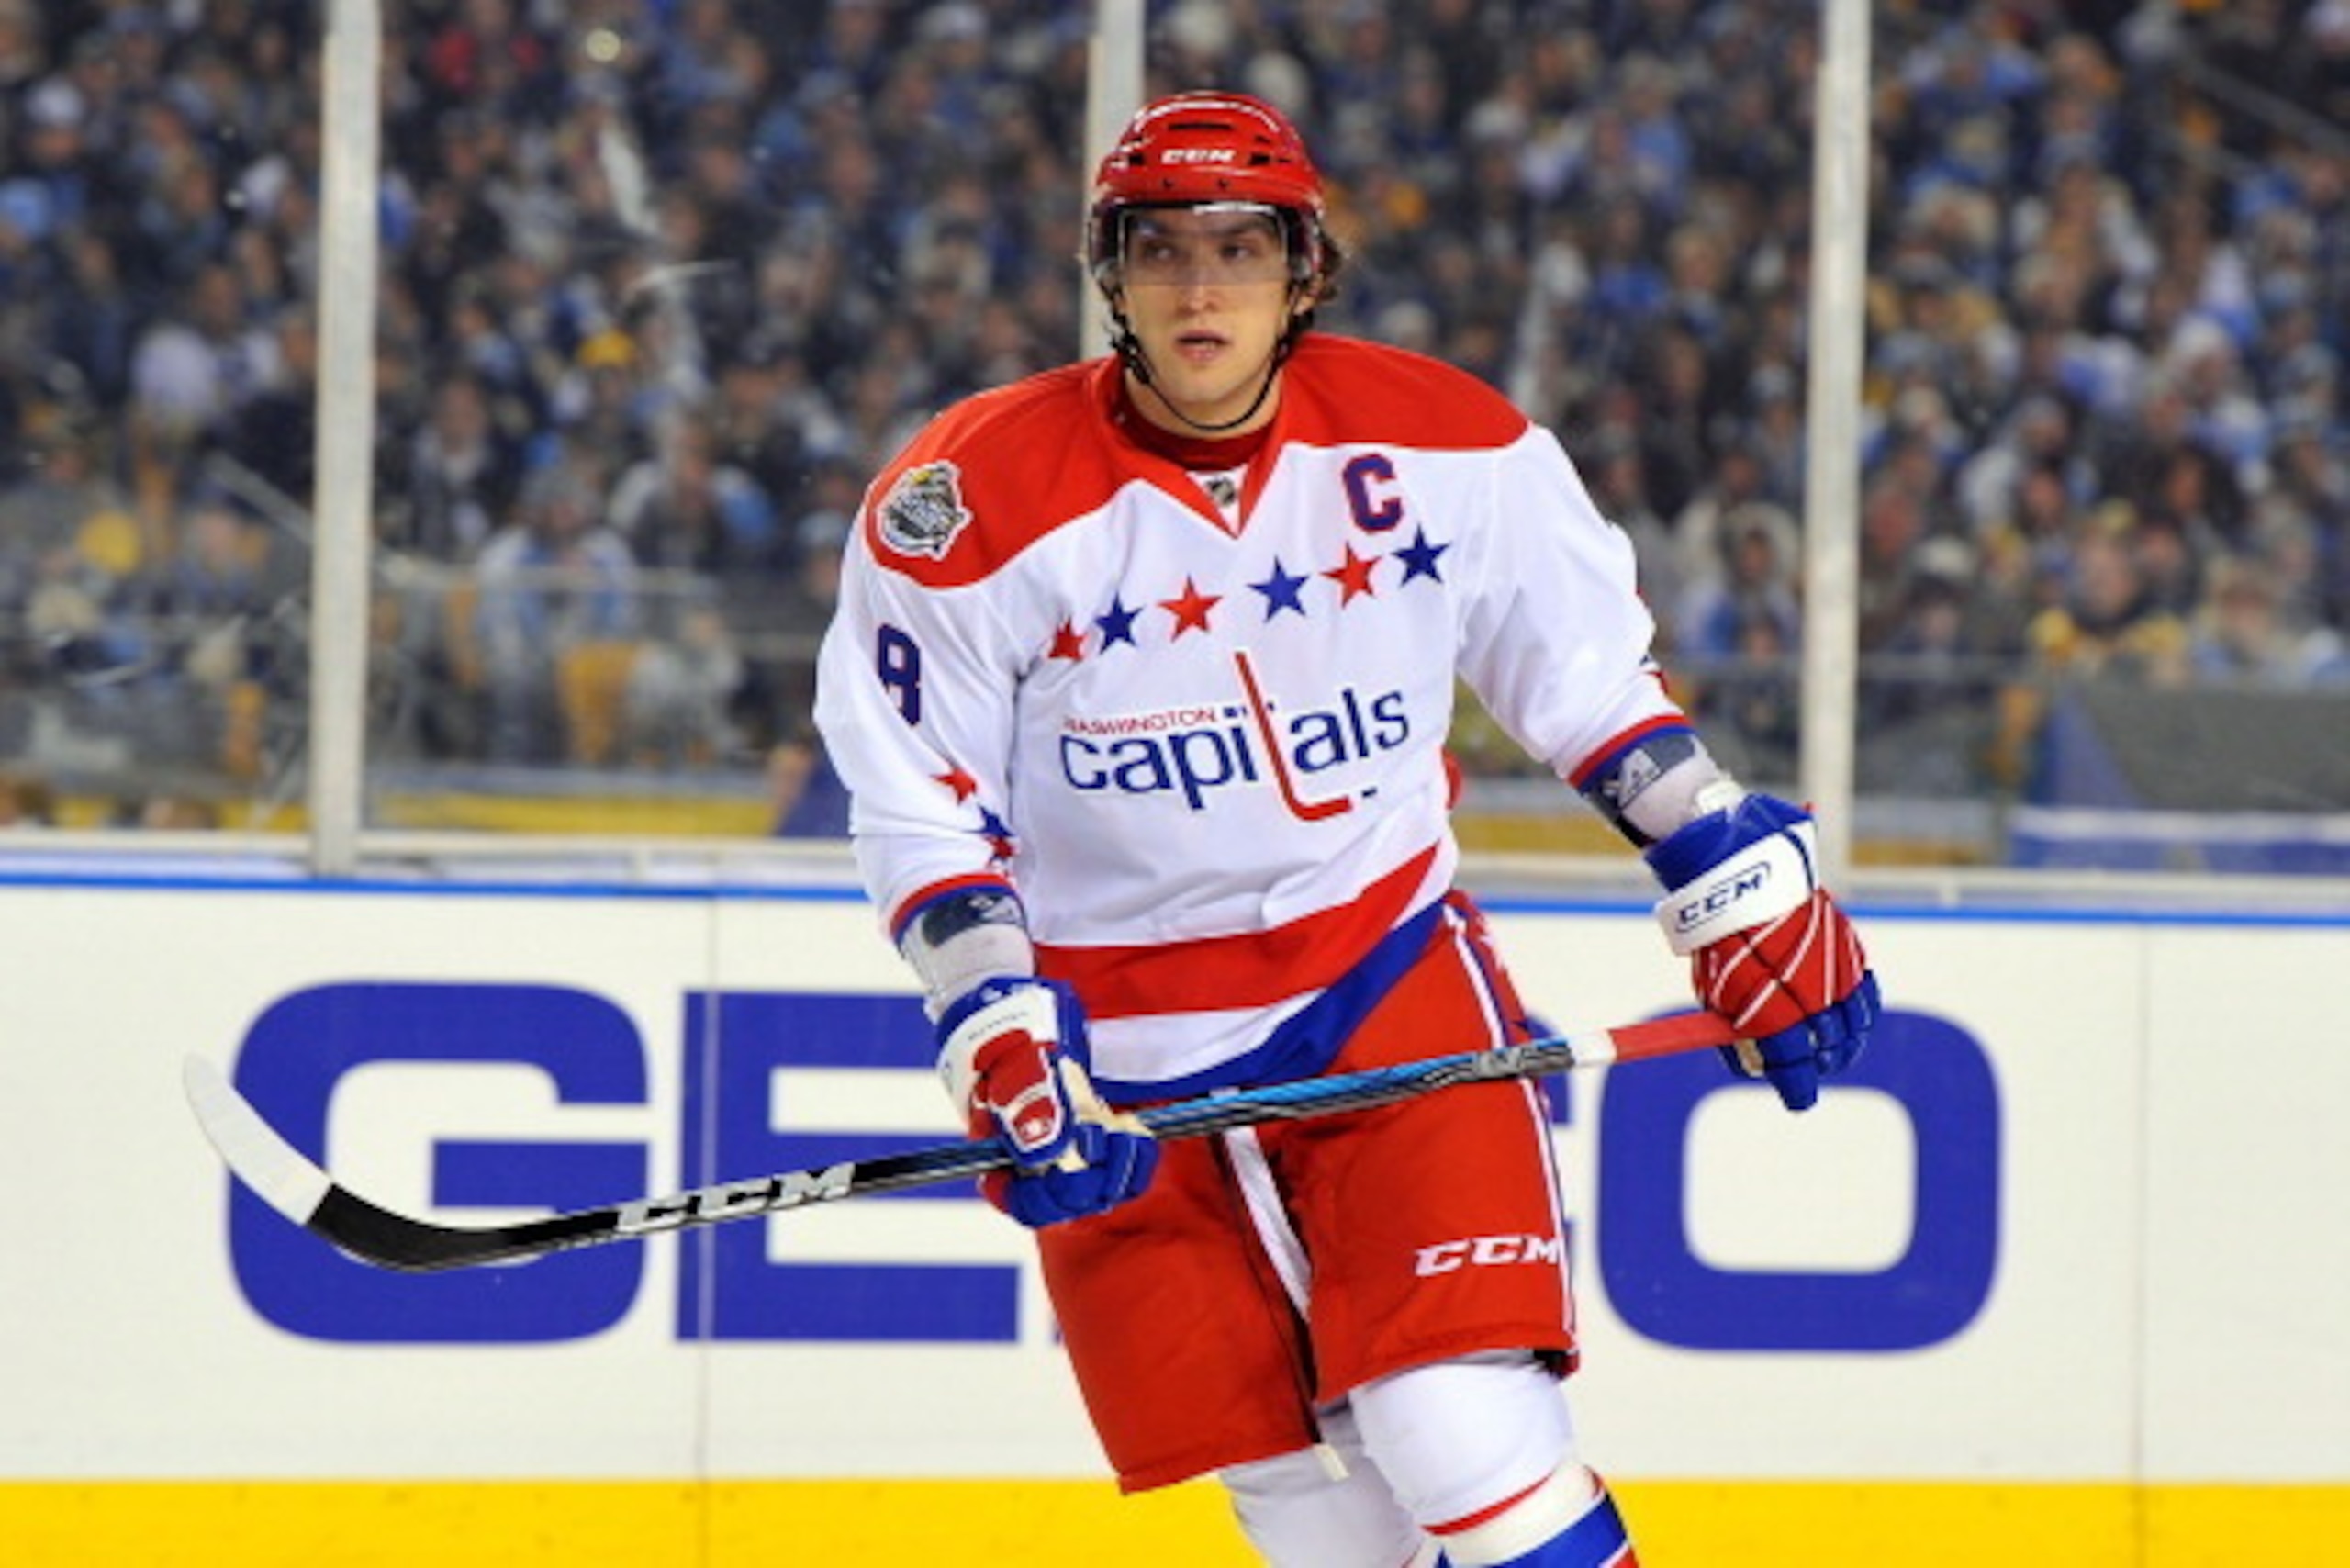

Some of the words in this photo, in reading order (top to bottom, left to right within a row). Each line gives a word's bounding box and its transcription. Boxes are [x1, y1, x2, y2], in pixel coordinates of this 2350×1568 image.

[1161, 149, 1236, 164] CCM
[1343, 454, 1404, 534] C
[878, 623, 921, 726] 8
[1679, 873, 1762, 924] CCM
[227, 980, 2001, 1353] GEO
[616, 1162, 855, 1232] CCM
[1415, 1235, 1559, 1277] CCM
